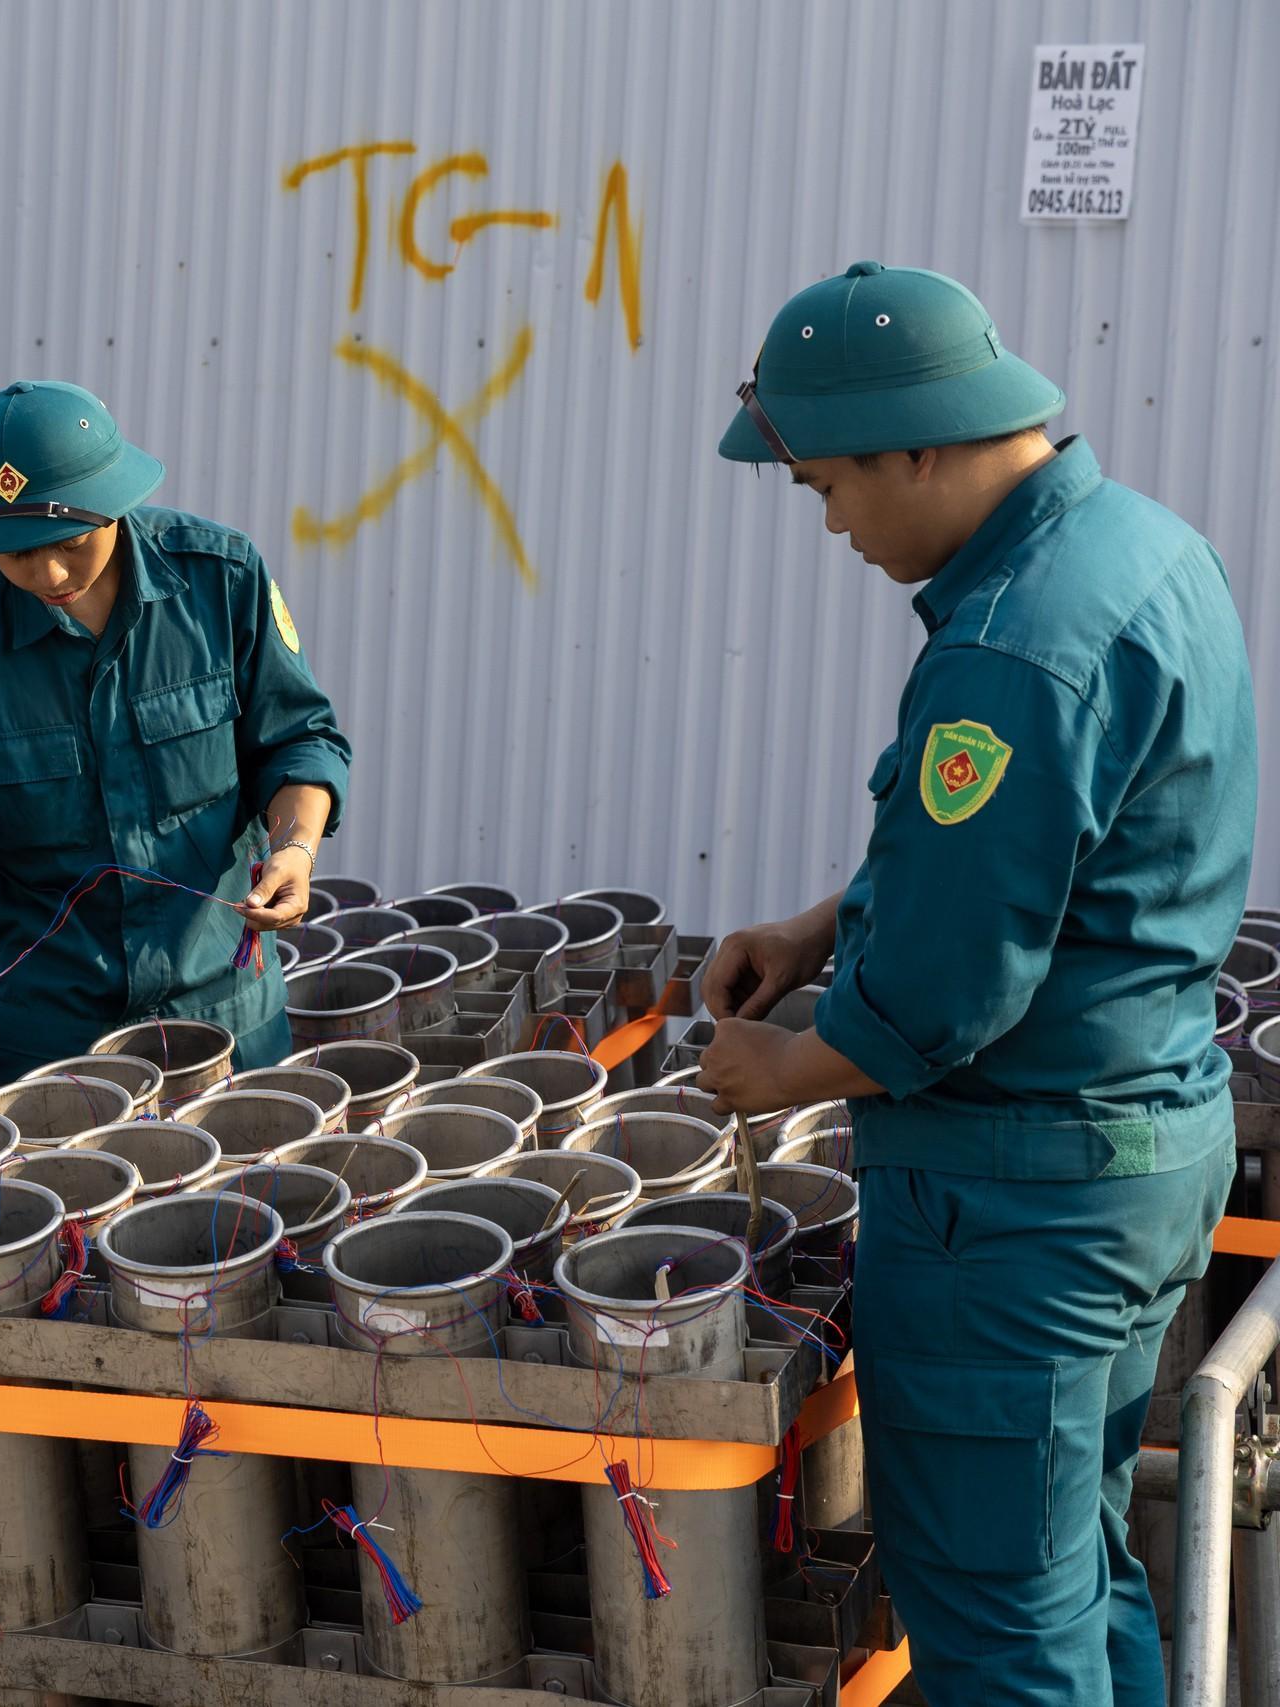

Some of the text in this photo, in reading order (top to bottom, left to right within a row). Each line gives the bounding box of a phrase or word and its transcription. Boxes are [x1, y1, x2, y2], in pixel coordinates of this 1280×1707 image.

[1039, 50, 1137, 91] BÁN ĐẤT
[1088, 95, 1116, 114] Lạc
[1028, 188, 1123, 214] 0945.416.213
